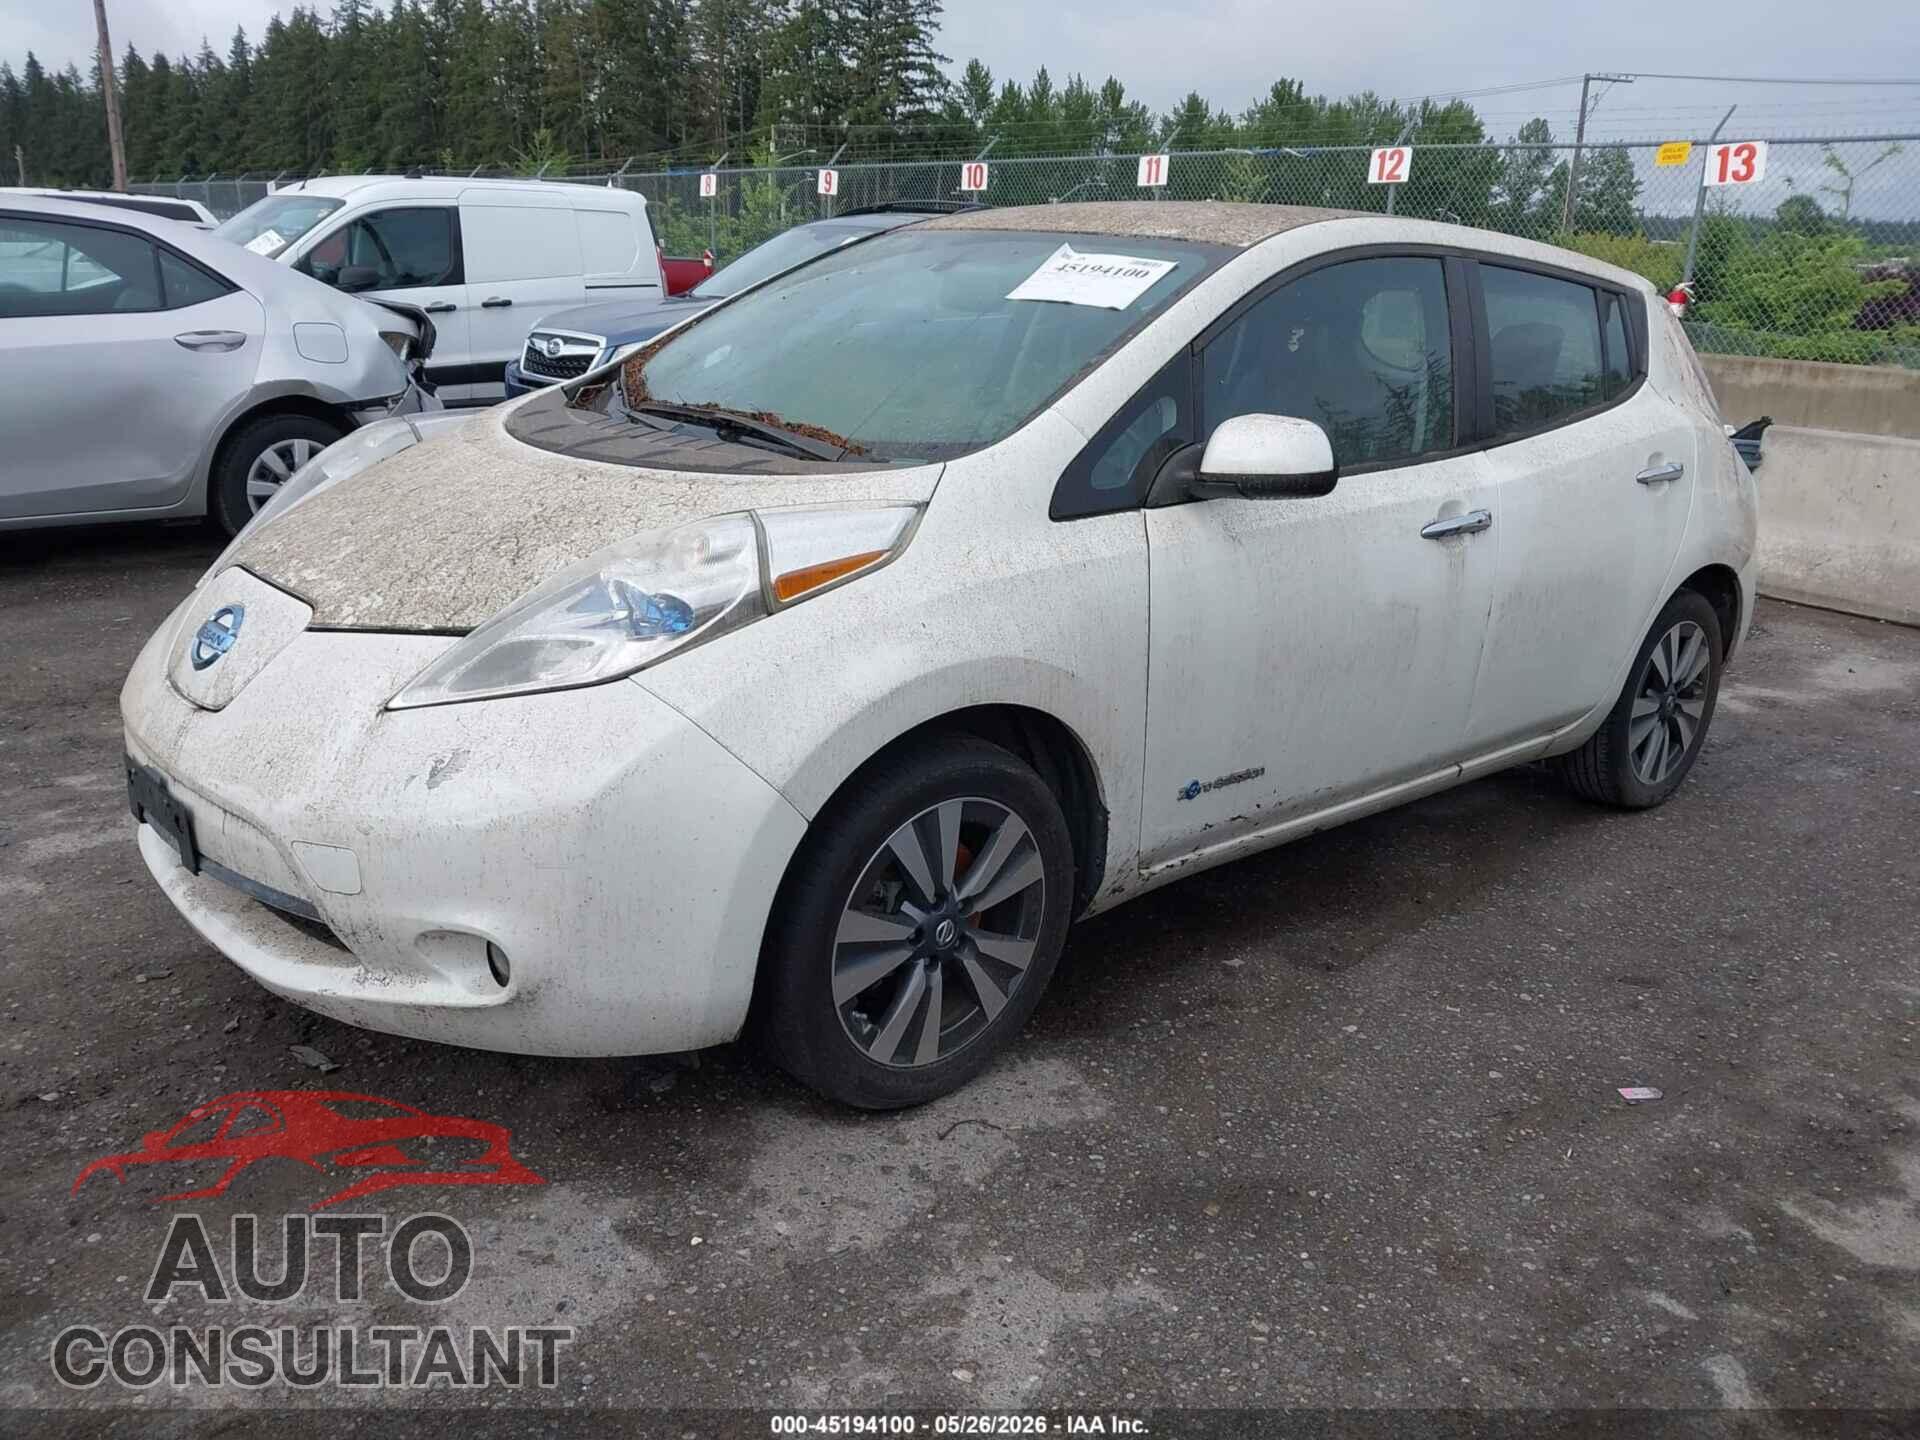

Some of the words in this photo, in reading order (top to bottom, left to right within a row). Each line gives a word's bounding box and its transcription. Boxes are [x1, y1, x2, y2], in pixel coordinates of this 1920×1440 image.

[1146, 158, 1161, 184] 11
[1377, 150, 1404, 181] 12
[1717, 143, 1757, 183] 13
[705, 176, 712, 194] 8
[823, 171, 832, 192] 9
[966, 164, 983, 188] 10
